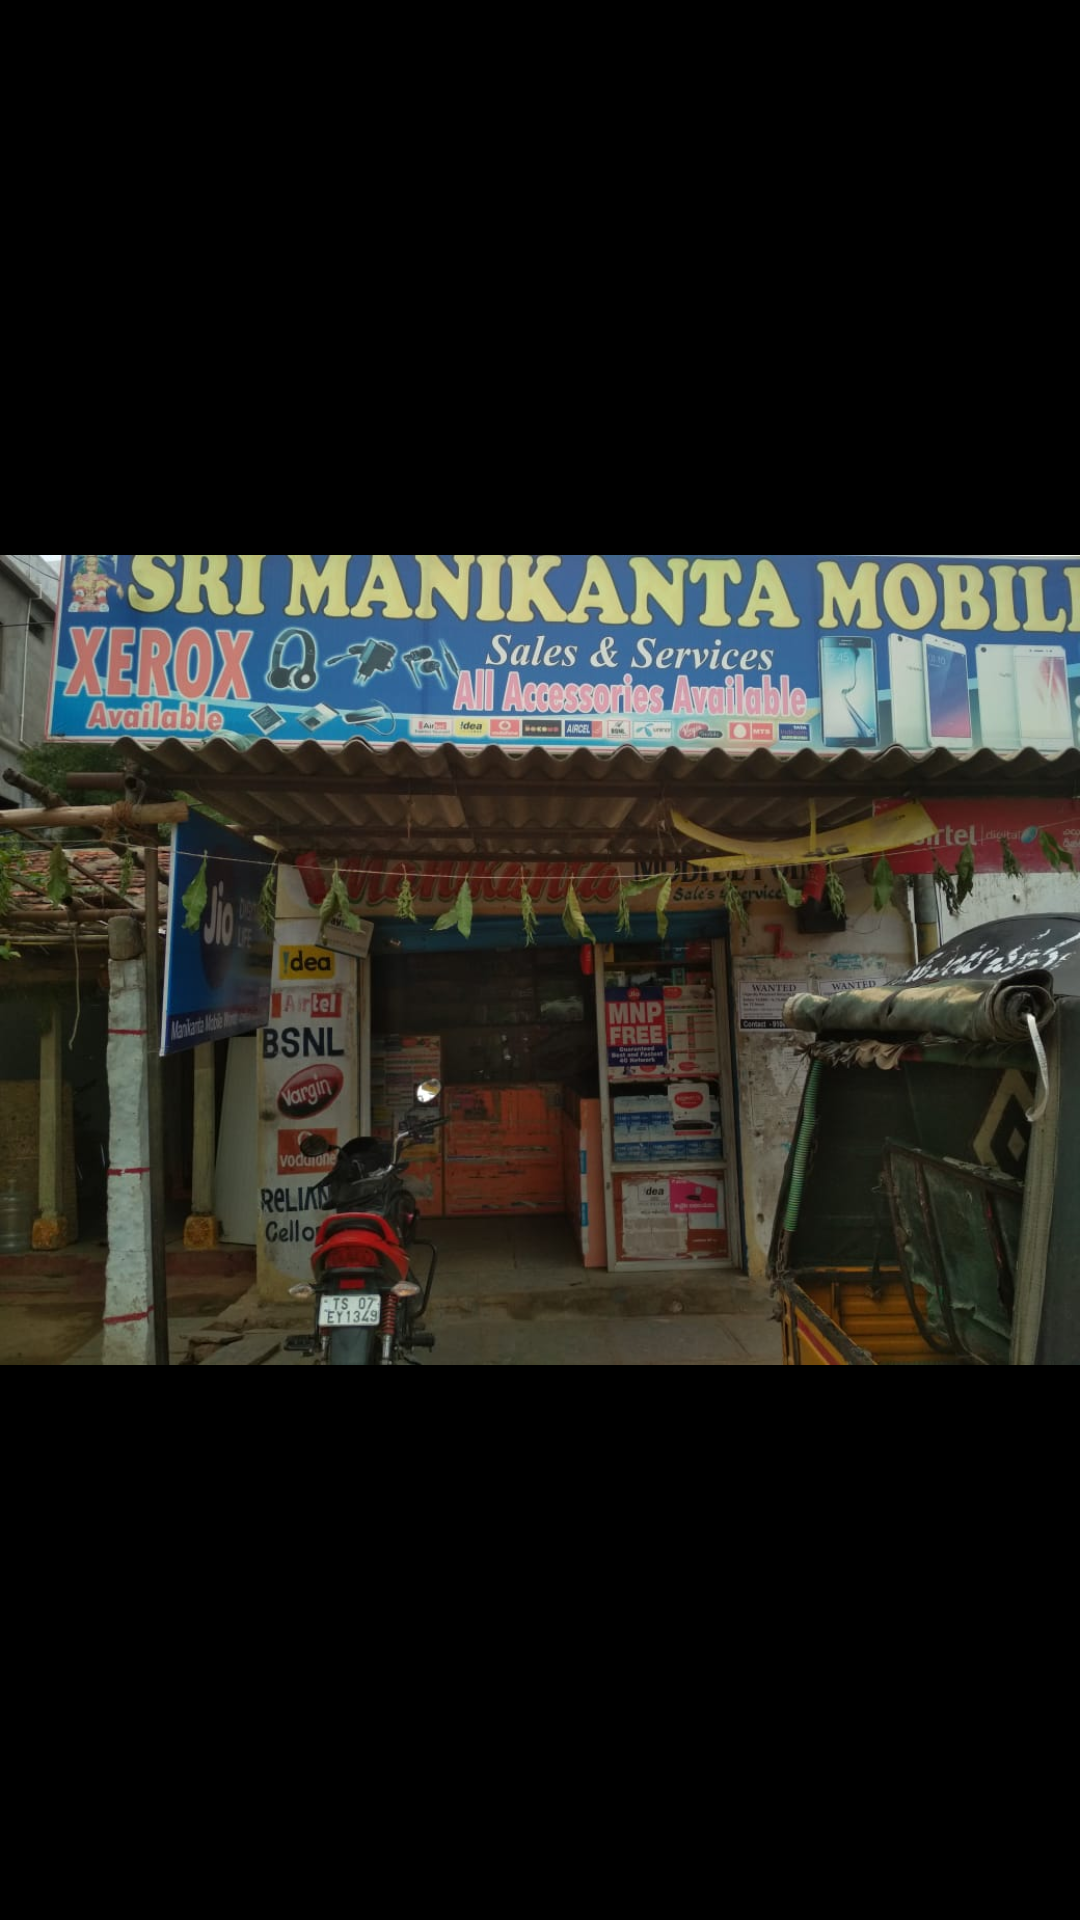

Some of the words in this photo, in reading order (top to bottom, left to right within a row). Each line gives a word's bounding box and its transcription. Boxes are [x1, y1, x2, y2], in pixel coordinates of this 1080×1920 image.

[128, 555, 265, 616] SRI
[284, 555, 800, 628] MANIKANTA
[63, 627, 253, 700] XEROX
[485, 633, 578, 668] Sales
[589, 636, 619, 669] &
[630, 637, 774, 671] Services
[452, 668, 495, 712] All
[502, 671, 664, 715] Accessories
[671, 674, 806, 718] Available
[86, 701, 224, 731] Available
[566, 723, 591, 734] AIRCEL
[203, 880, 234, 947] Jio
[752, 984, 797, 992] WANTED
[831, 980, 877, 990] WANTED
[608, 1001, 662, 1025] MNP
[742, 1020, 767, 1028] Contact
[262, 1026, 345, 1059] BSNL
[609, 1024, 664, 1046] FREE
[333, 1297, 349, 1310] TS
[358, 1296, 375, 1310] 07
